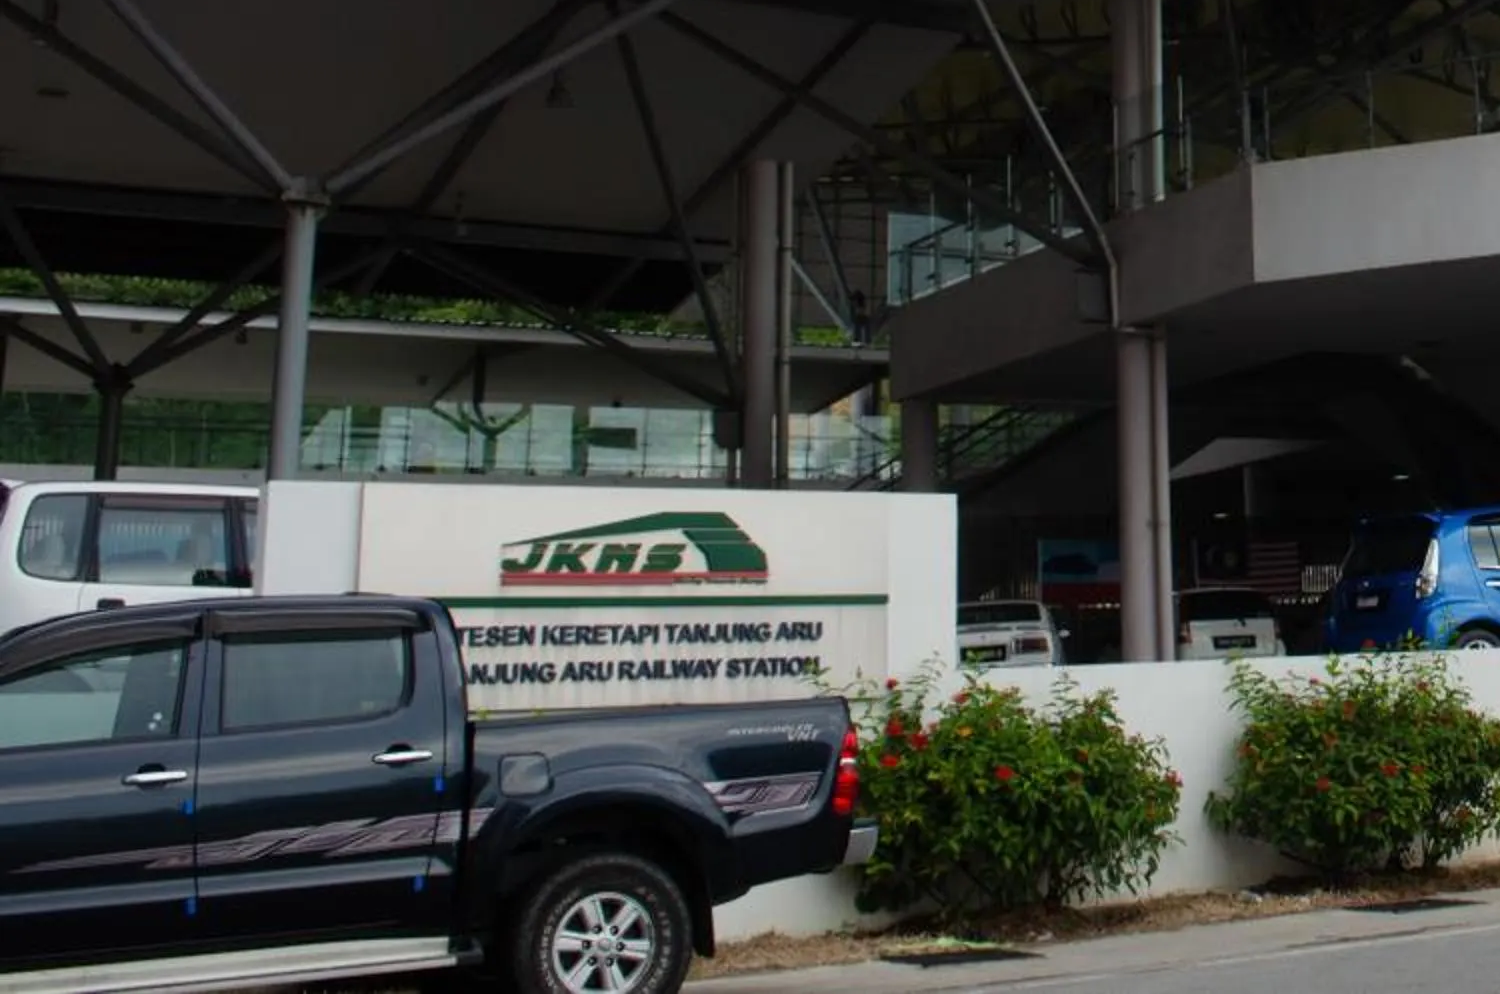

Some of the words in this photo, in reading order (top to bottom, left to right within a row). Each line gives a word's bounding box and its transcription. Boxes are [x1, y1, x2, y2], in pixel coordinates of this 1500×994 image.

[501, 542, 686, 573] JKNS
[459, 624, 535, 647] TESEN
[541, 623, 659, 646] KERETAPI
[664, 622, 772, 644] TANJUNG
[775, 621, 823, 642] ARU
[467, 661, 557, 685] ANJUNG
[559, 659, 615, 683] ARU
[618, 658, 722, 681] RAILWAY
[724, 656, 821, 679] STATION
